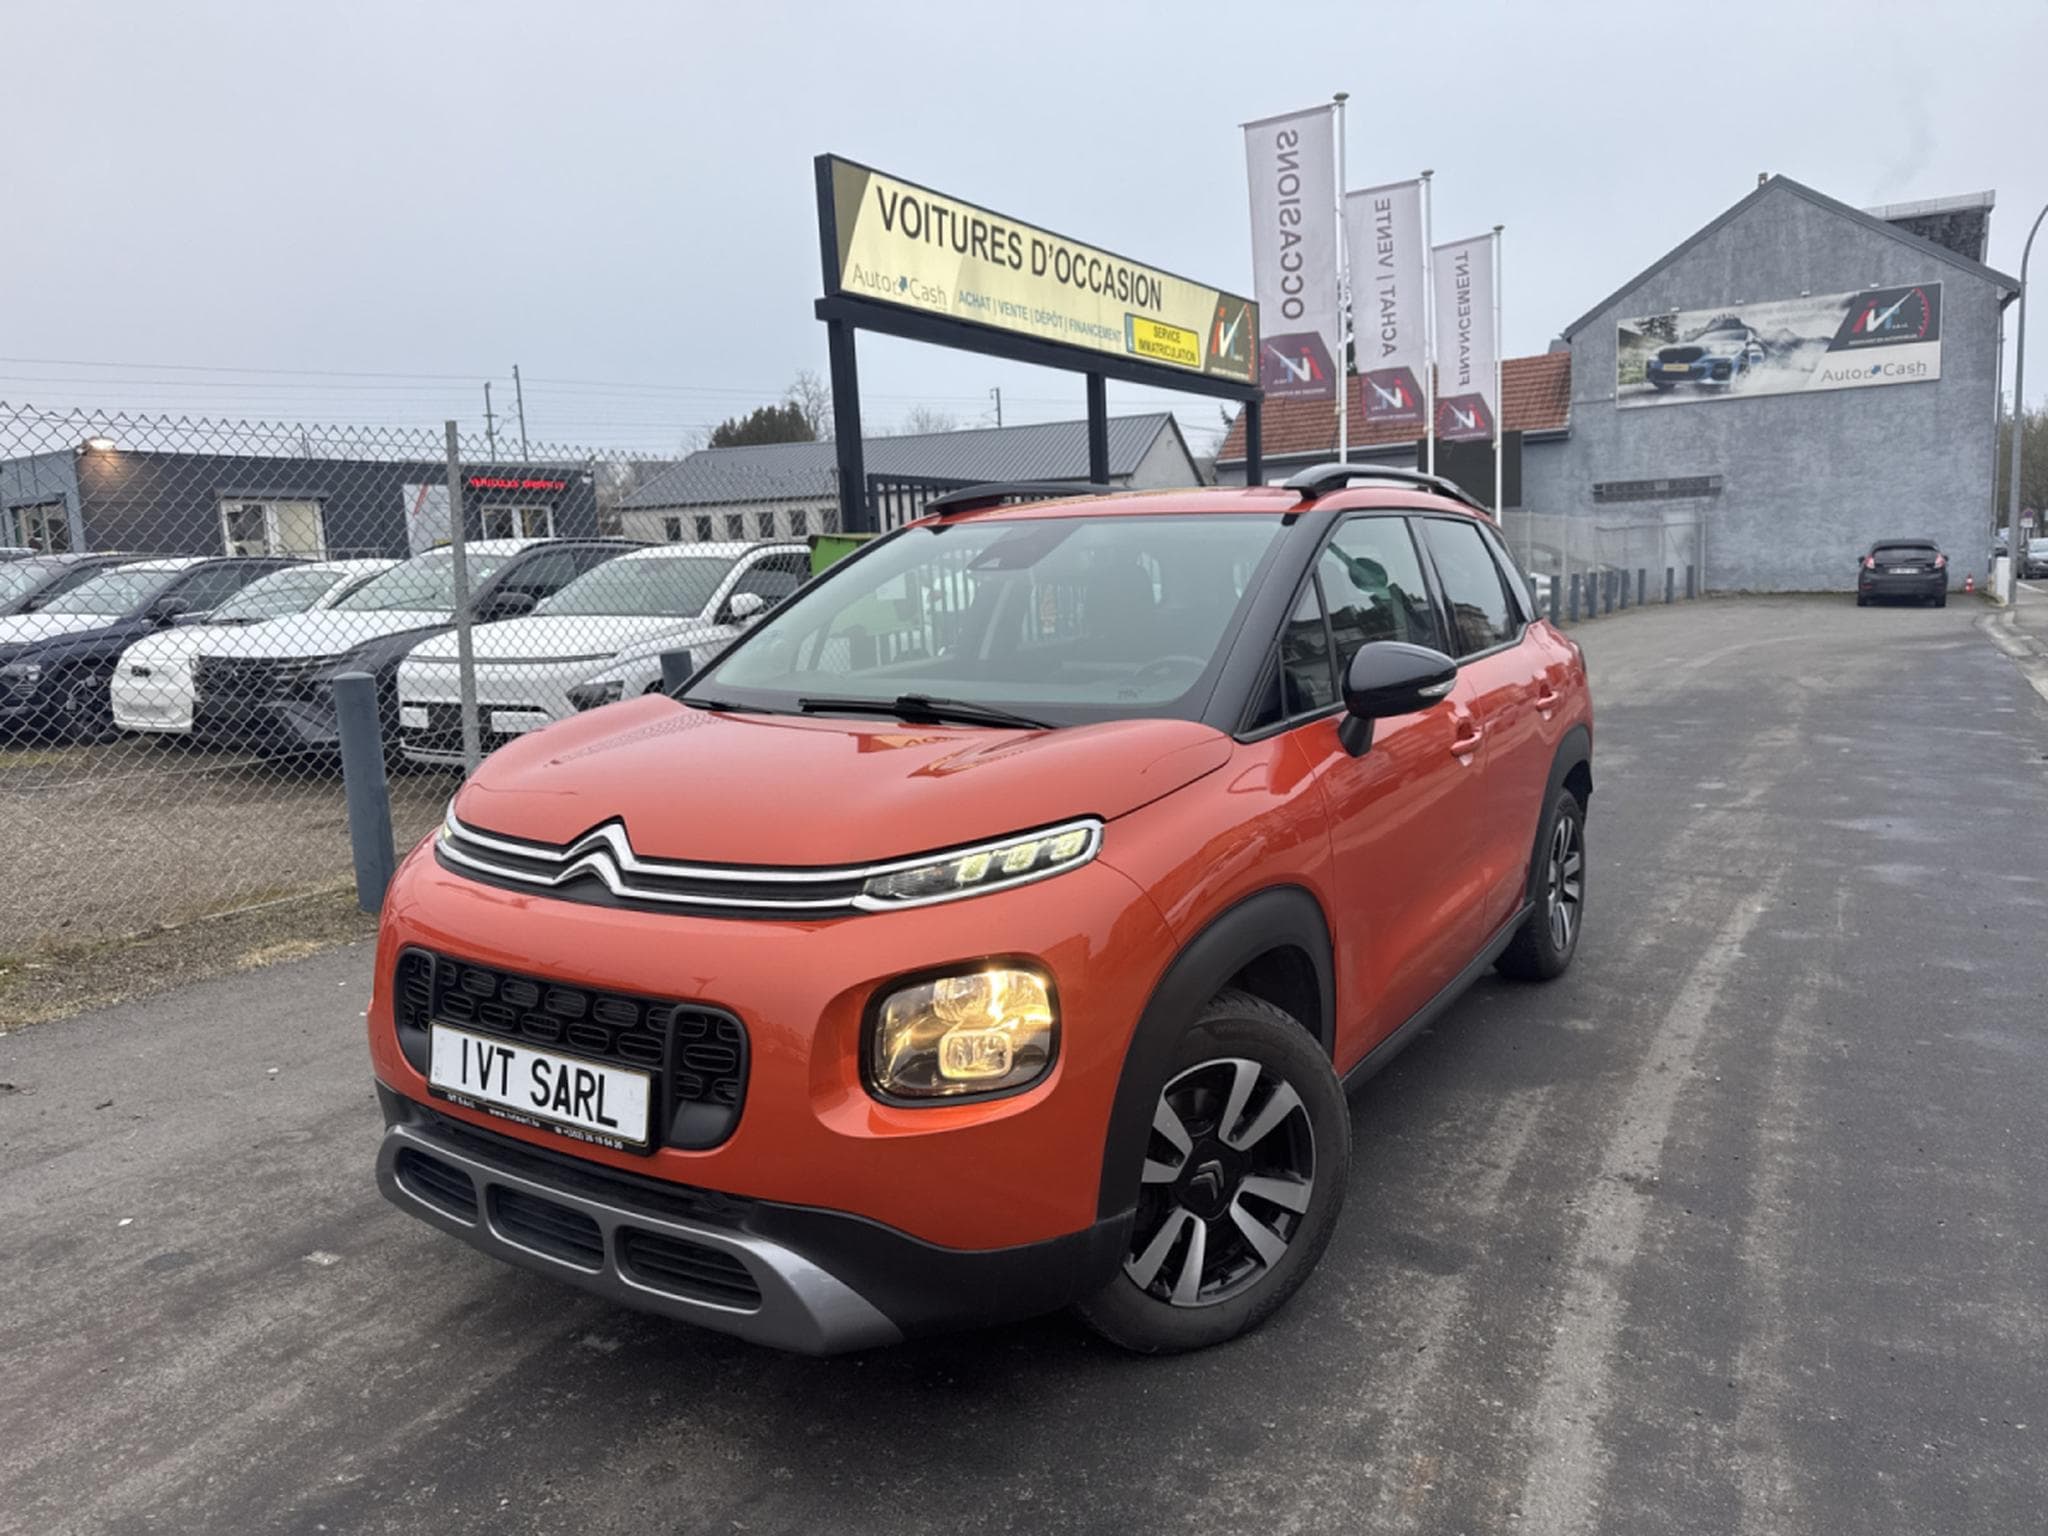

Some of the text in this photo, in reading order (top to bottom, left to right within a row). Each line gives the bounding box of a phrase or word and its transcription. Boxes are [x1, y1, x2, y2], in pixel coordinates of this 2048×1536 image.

[876, 185, 1162, 312] VOITURES D'OCCASION
[909, 278, 947, 306] Cash
[959, 290, 991, 312] ACHAT
[998, 299, 1028, 321] VENTE
[1069, 317, 1122, 342] FINANCEMENT
[1153, 325, 1181, 343] SERVICE
[1883, 361, 1927, 377] Cash
[530, 1058, 619, 1128] SARL
